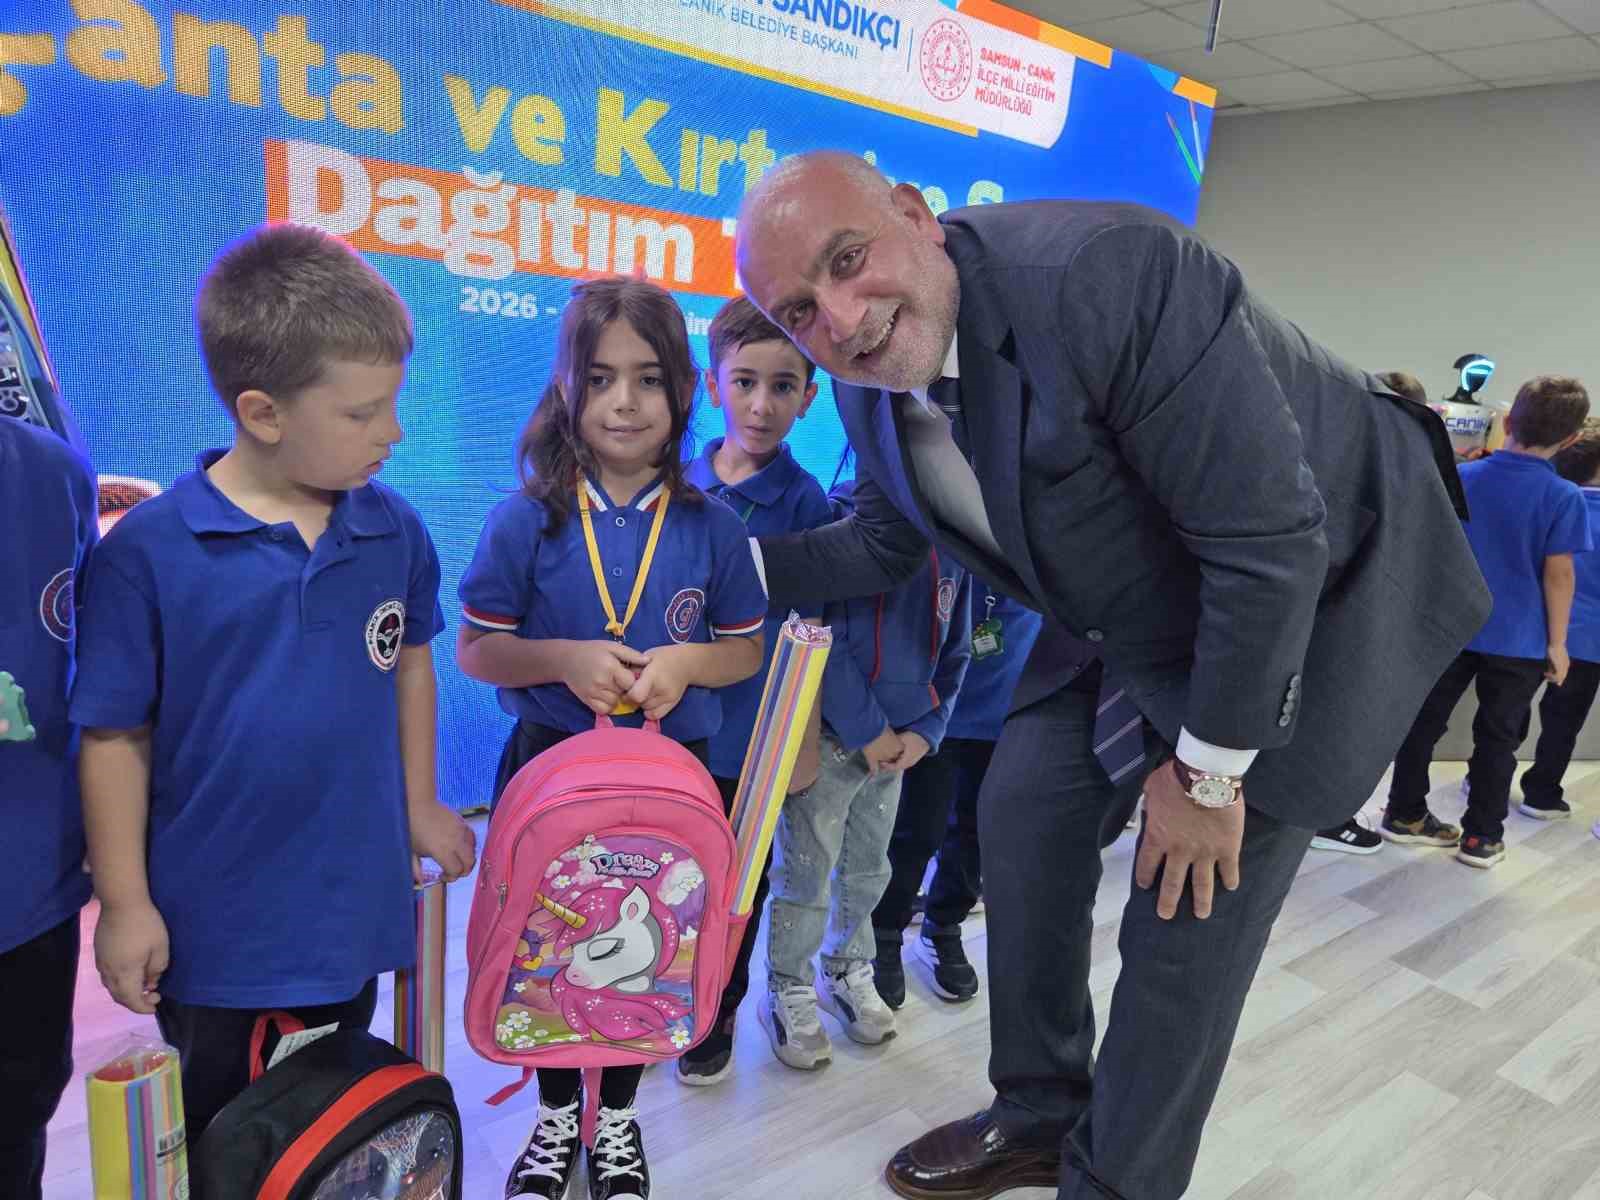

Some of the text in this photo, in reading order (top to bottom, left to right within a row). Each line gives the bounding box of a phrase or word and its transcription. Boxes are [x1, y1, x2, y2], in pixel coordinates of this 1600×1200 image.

[730, 7, 798, 42] BELEDİYE
[801, 29, 859, 60] BAŞKANI
[976, 64, 1000, 86] İLÇE
[979, 47, 1021, 72] SAMSUN
[442, 72, 567, 166] ve
[285, 139, 694, 284] Dağıtım
[458, 286, 538, 318] 2026
